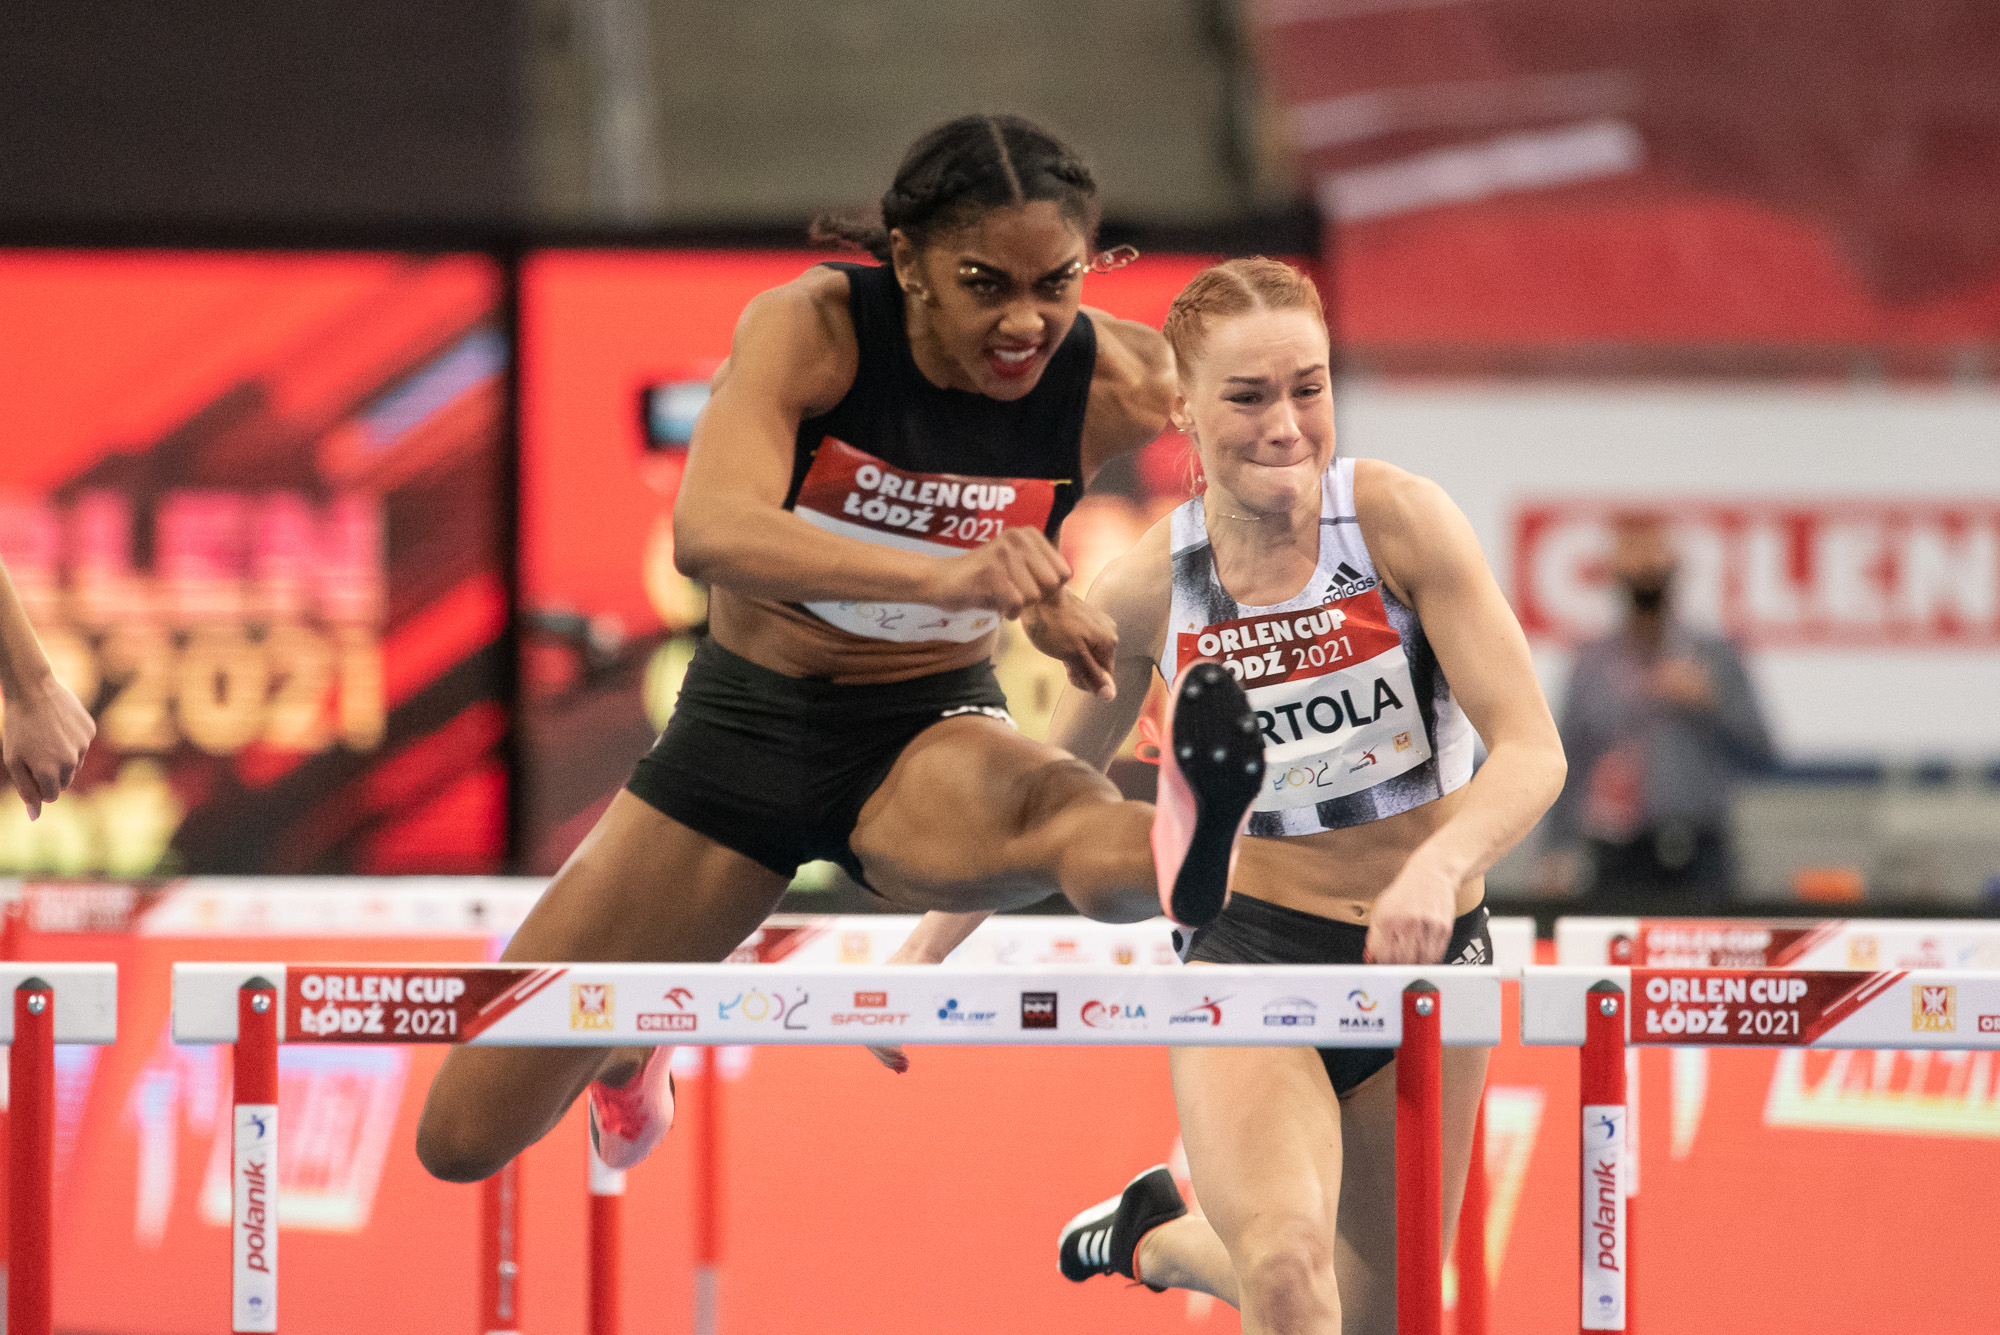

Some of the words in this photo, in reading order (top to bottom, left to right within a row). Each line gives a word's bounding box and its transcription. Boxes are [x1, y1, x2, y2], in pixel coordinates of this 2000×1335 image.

[855, 464, 960, 508] ORLEN
[961, 484, 1016, 511] CUP
[843, 492, 935, 533] ŁÓDŹ
[938, 515, 1004, 542] 2021
[1322, 577, 1376, 605] adidas
[1197, 619, 1294, 658] ORLEN
[1294, 608, 1347, 640] CUP
[1221, 645, 1287, 682] ÓDŹ
[1291, 635, 1354, 671] 2021
[1256, 677, 1404, 746] RTOLA
[301, 975, 403, 1003] ORLEN
[406, 977, 466, 1004] CUP
[1645, 977, 1747, 1003] ORLEN
[1750, 978, 1808, 1004] CUP
[301, 1000, 385, 1035] ŁÓDŹ
[393, 1008, 458, 1035] 2021
[639, 1014, 694, 1030] ORLEN
[831, 1012, 910, 1026] SPORT
[1645, 1003, 1728, 1035] ŁÓDŹ
[1738, 1009, 1800, 1036] 2021
[242, 1159, 271, 1275] polanik
[1592, 1159, 1620, 1272] polanik
